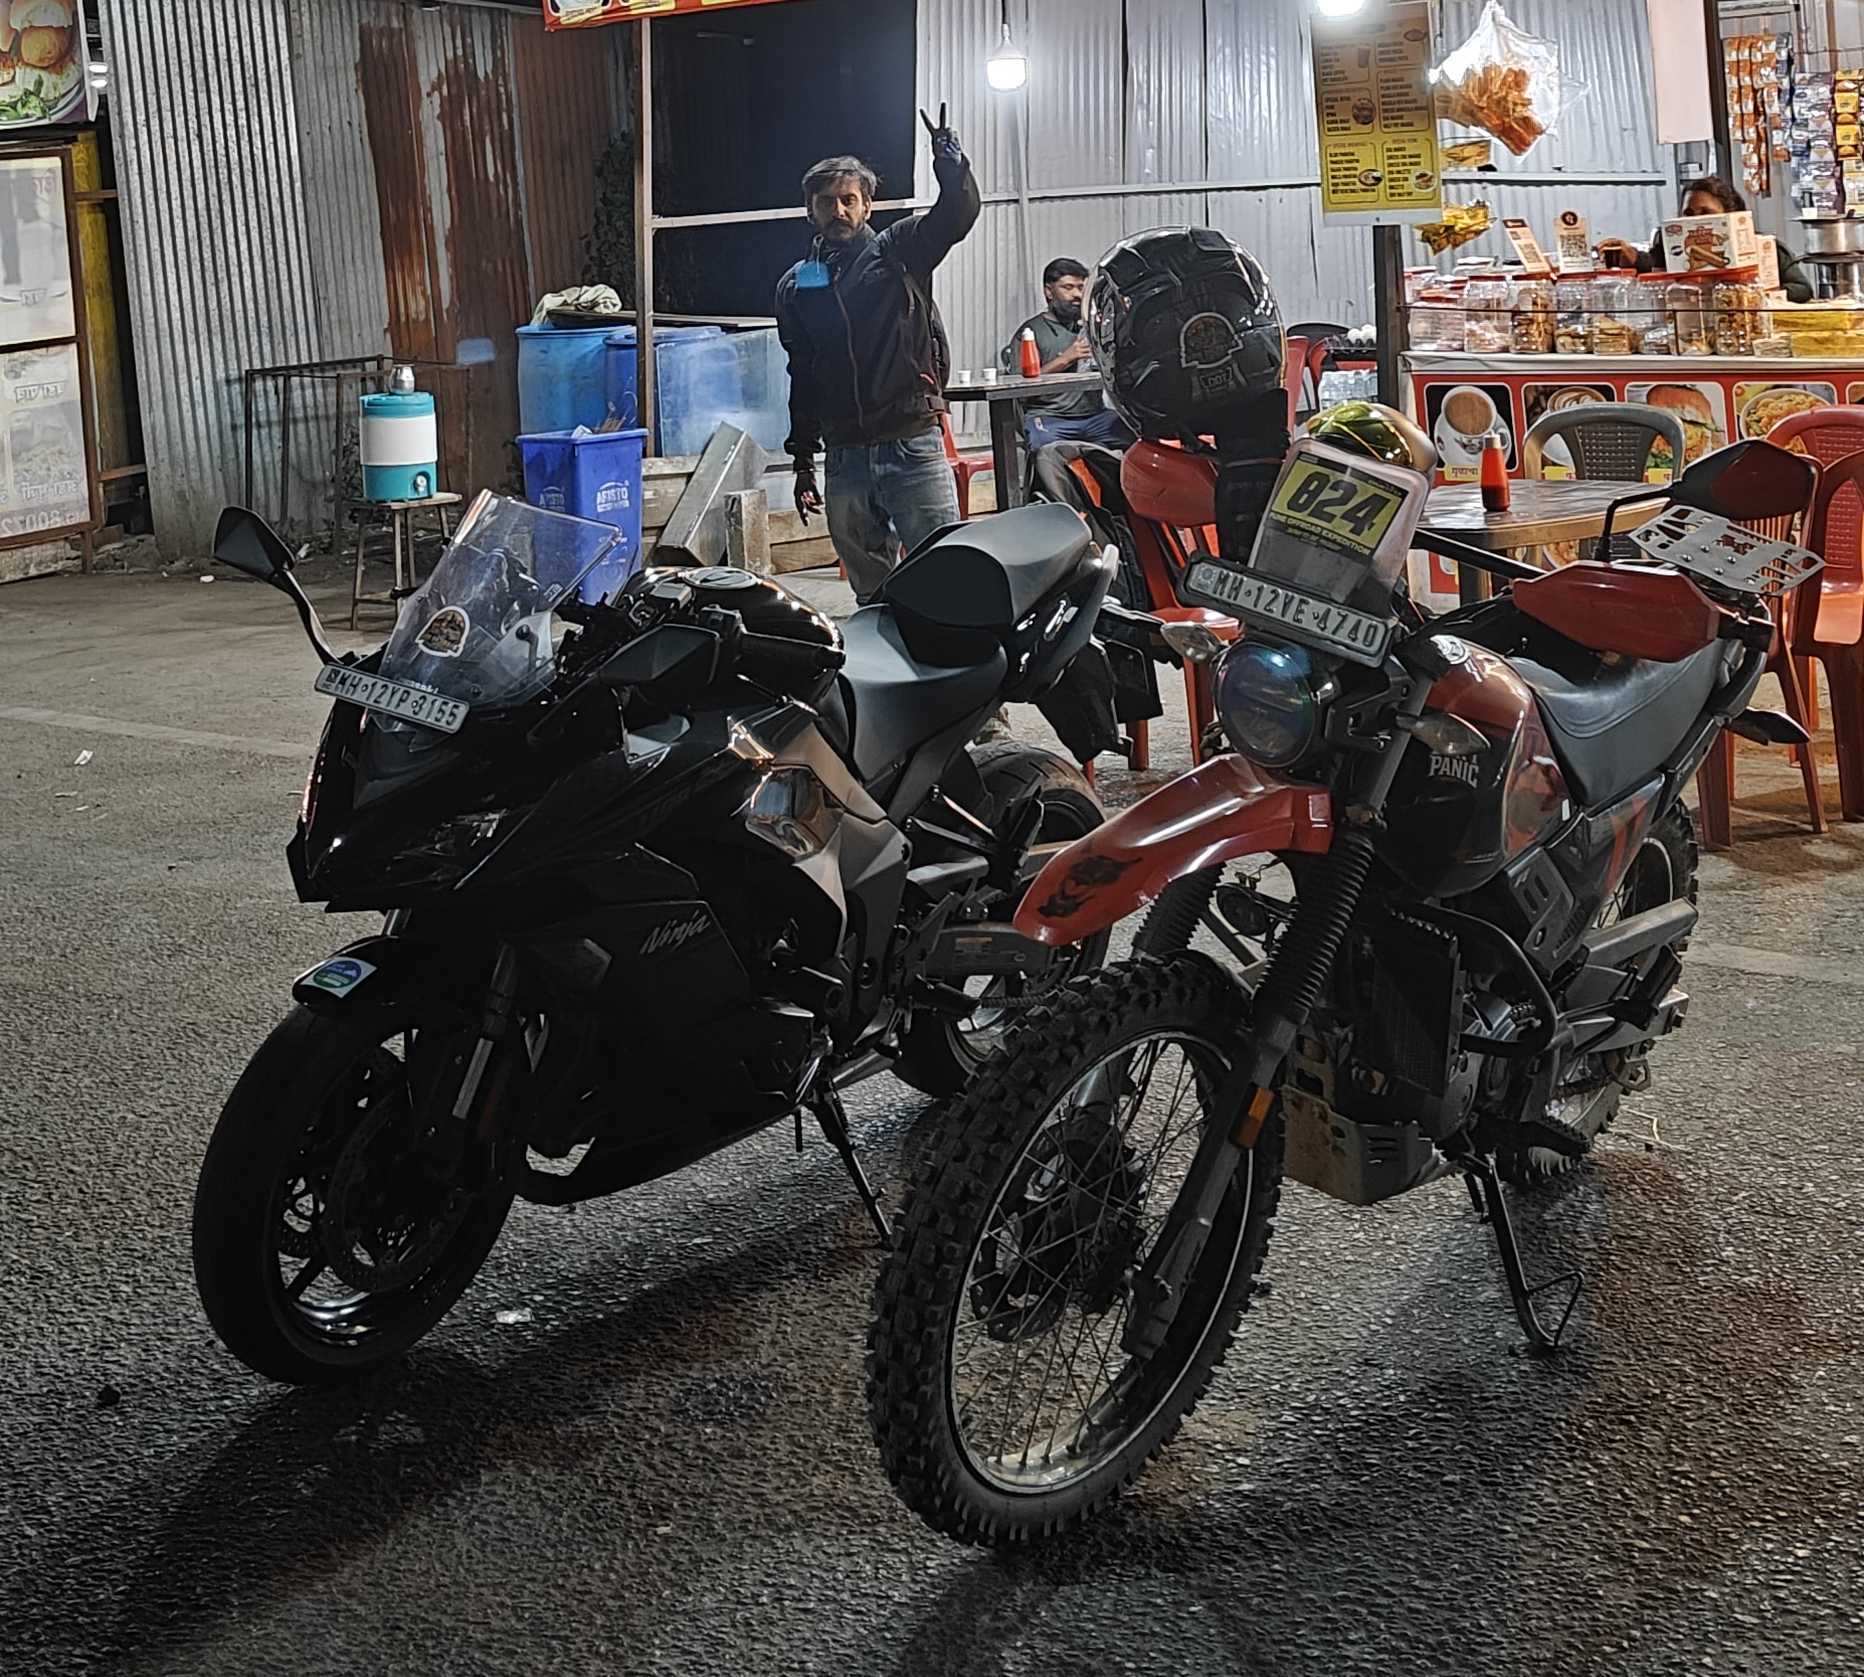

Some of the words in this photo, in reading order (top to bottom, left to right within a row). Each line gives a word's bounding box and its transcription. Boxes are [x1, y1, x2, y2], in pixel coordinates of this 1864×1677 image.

[1287, 471, 1393, 537] 824
[1428, 755, 1480, 788] PANIC
[640, 909, 711, 954] Ninja
